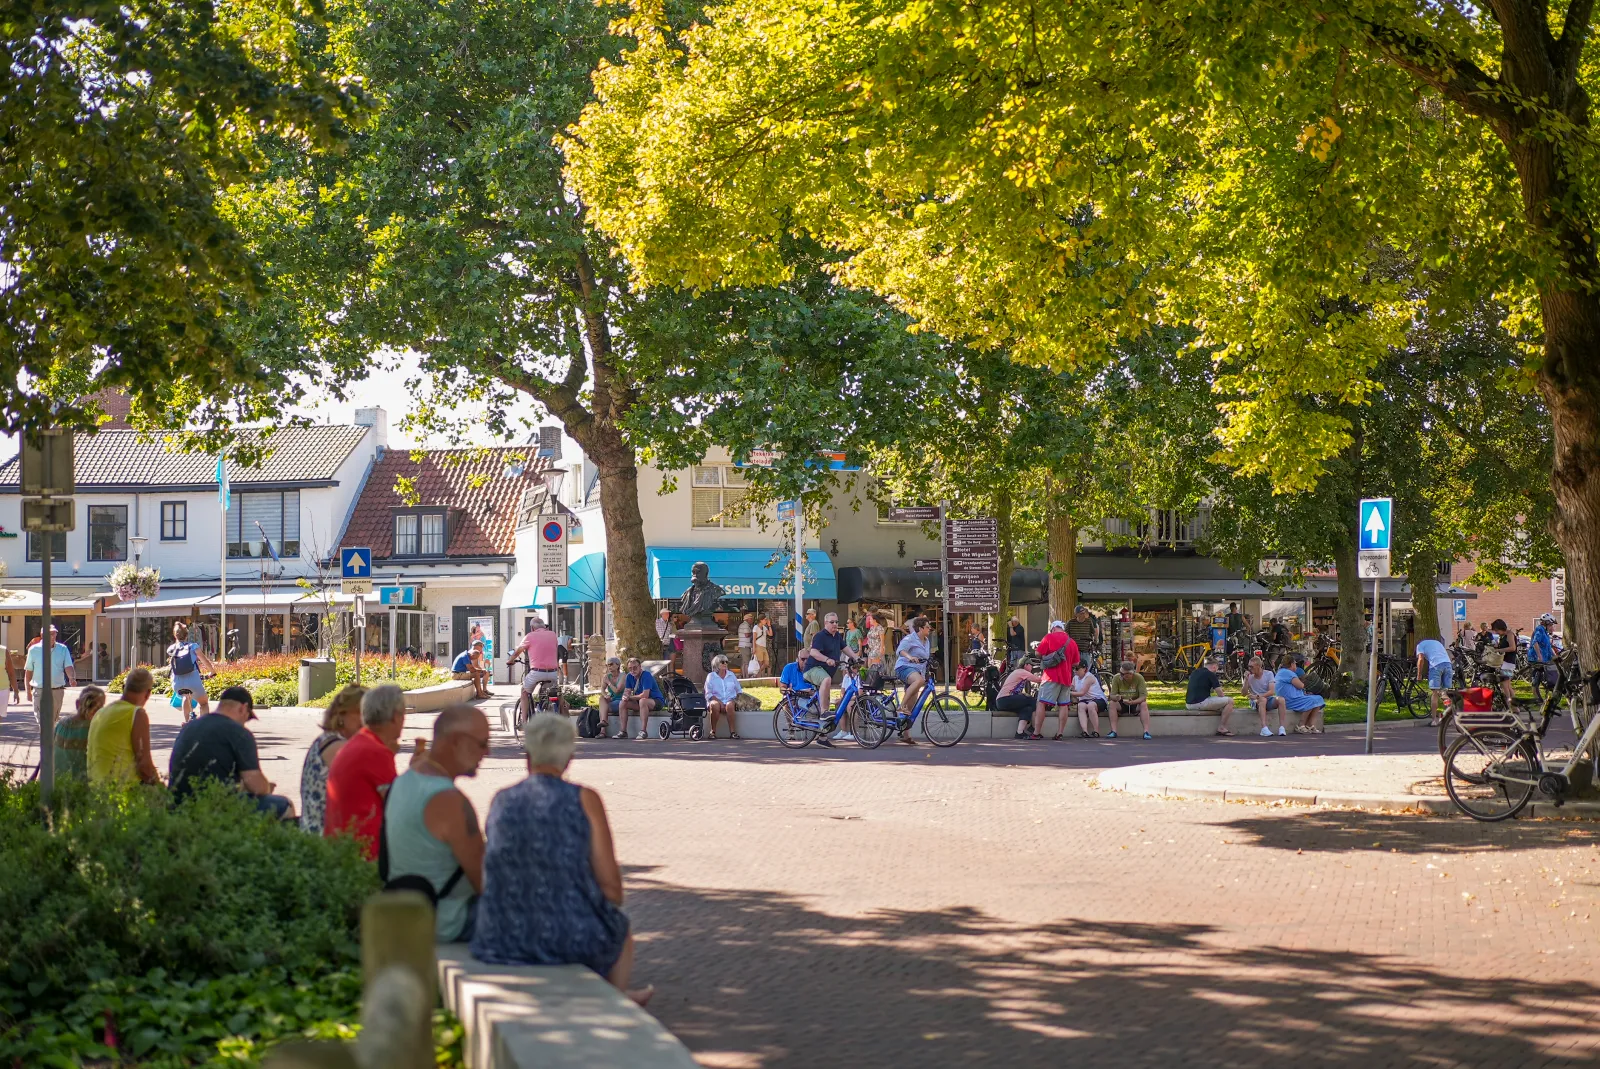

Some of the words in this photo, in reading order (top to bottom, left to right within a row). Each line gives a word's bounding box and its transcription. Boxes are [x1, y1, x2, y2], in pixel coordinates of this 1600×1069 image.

[719, 584, 755, 595] sem
[758, 582, 806, 595] Zeevs
[914, 587, 929, 598] De
